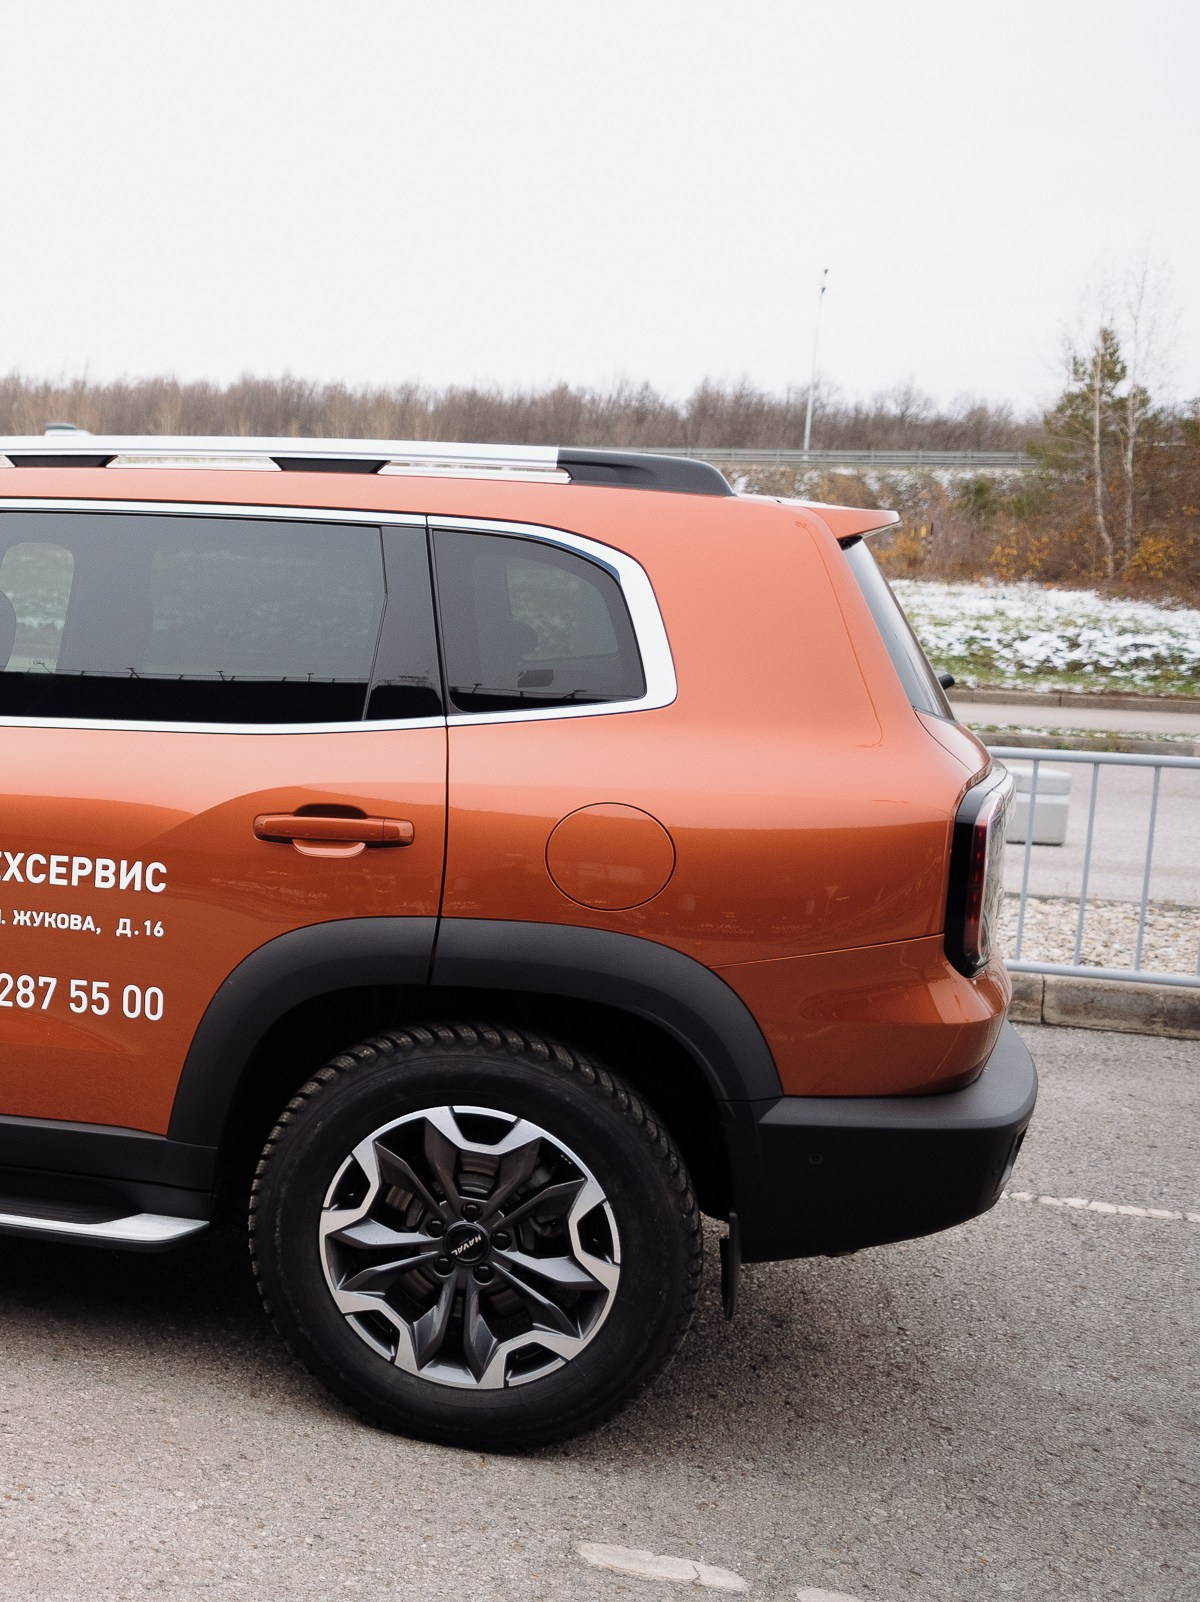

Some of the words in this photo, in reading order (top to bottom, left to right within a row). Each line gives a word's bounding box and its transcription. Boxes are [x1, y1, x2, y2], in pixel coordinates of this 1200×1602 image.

[12, 909, 102, 935] ЖУКОВА,
[69, 979, 110, 1016] 55
[122, 984, 164, 1021] 00
[450, 1233, 482, 1256] HAVAL
